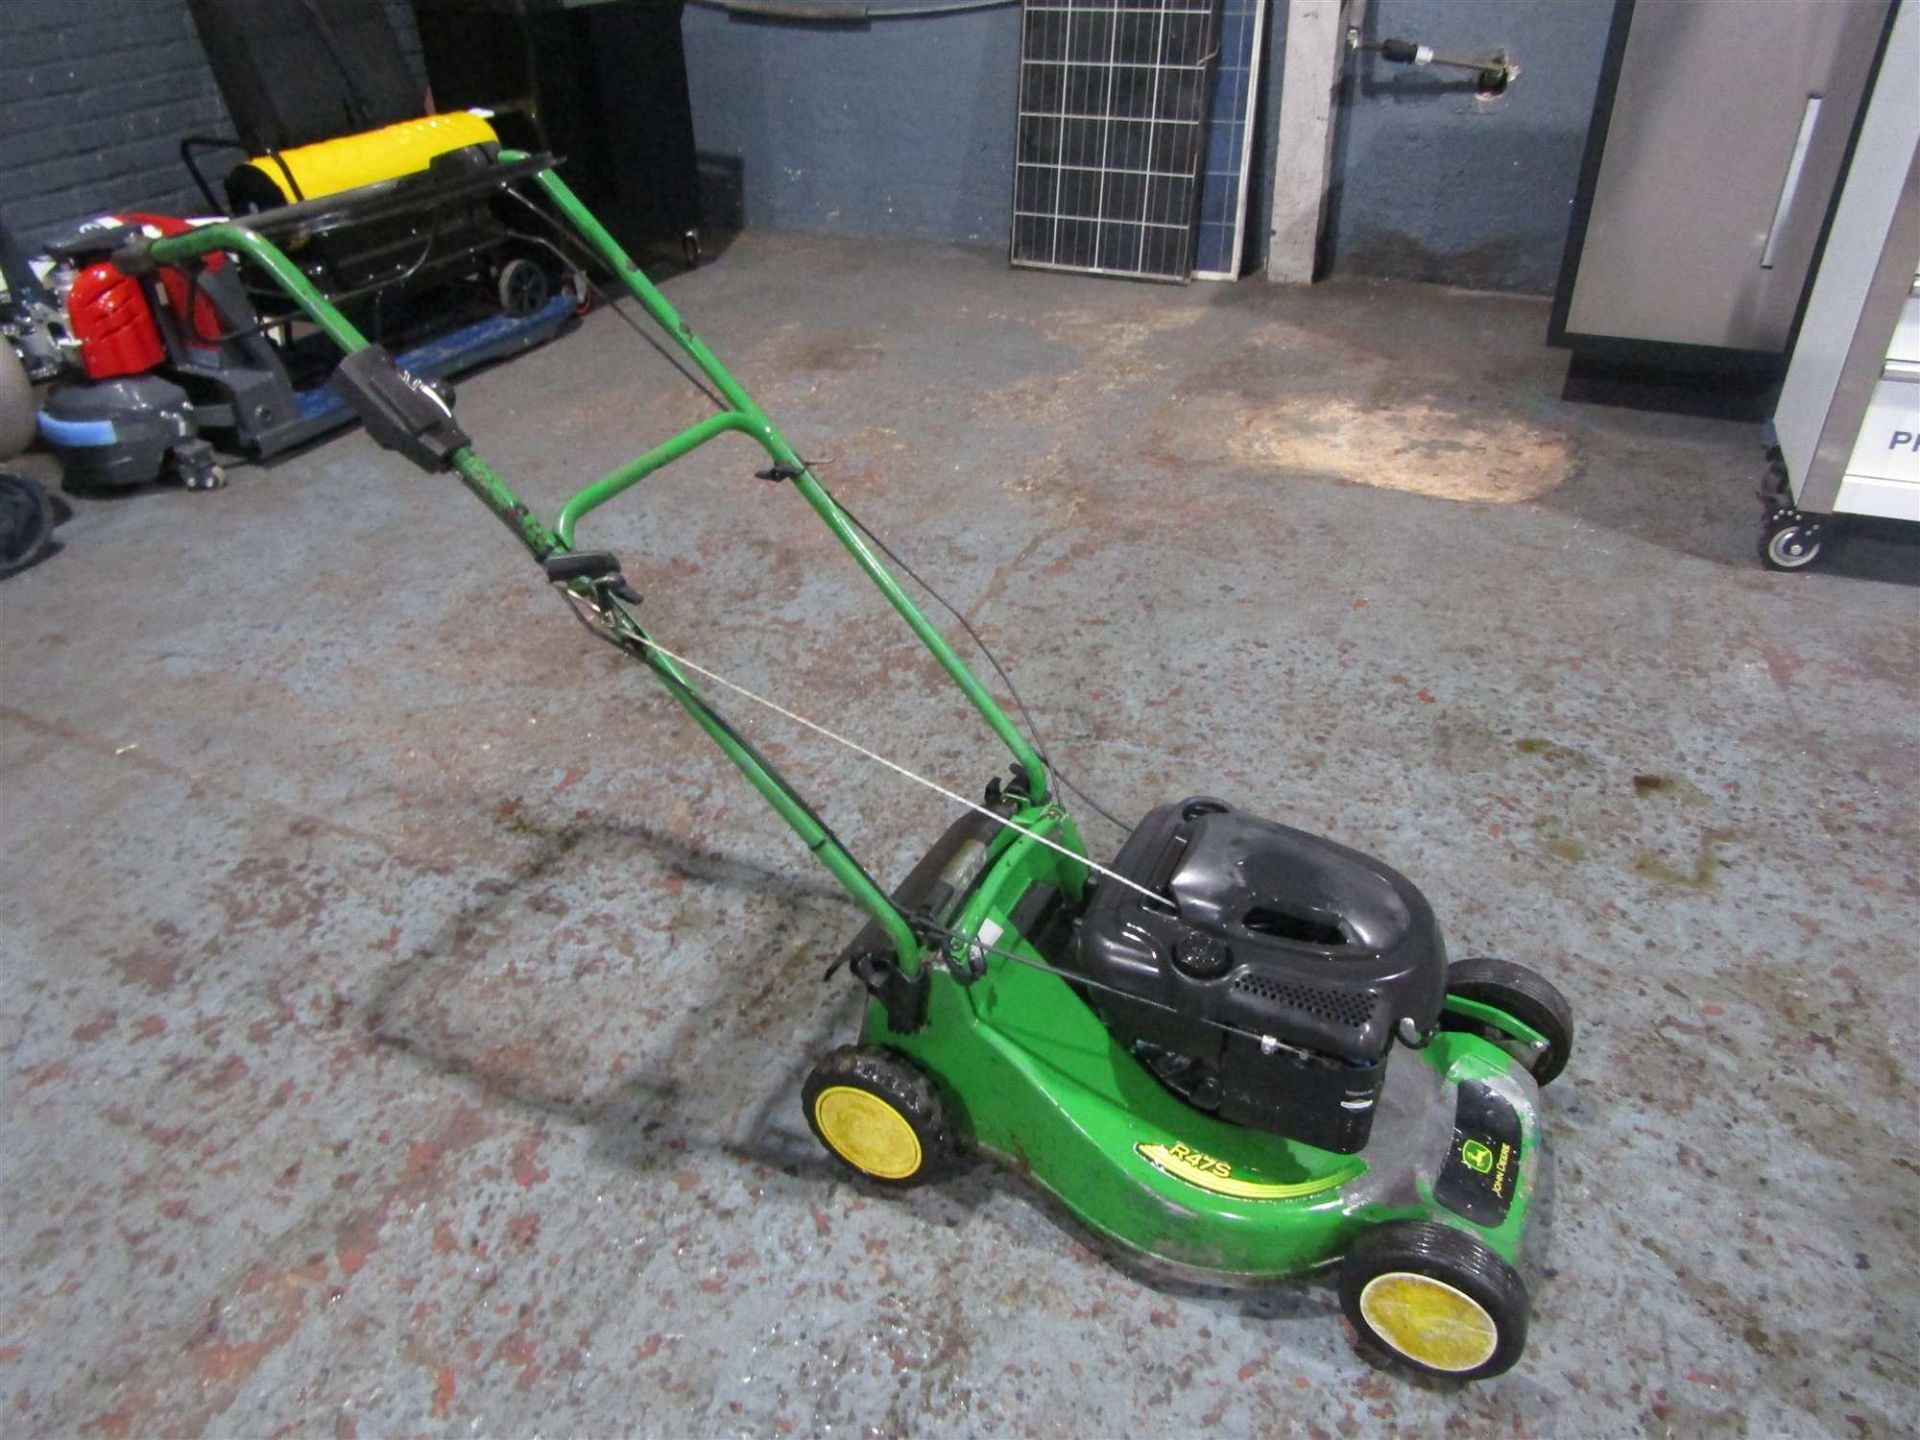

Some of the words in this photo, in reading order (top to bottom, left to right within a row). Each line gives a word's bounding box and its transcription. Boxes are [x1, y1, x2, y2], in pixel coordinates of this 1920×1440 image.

[1887, 430, 1920, 453] P
[1168, 1142, 1232, 1178] R47S
[1496, 1142, 1511, 1172] DEERE
[1492, 1170, 1505, 1199] JOHN
